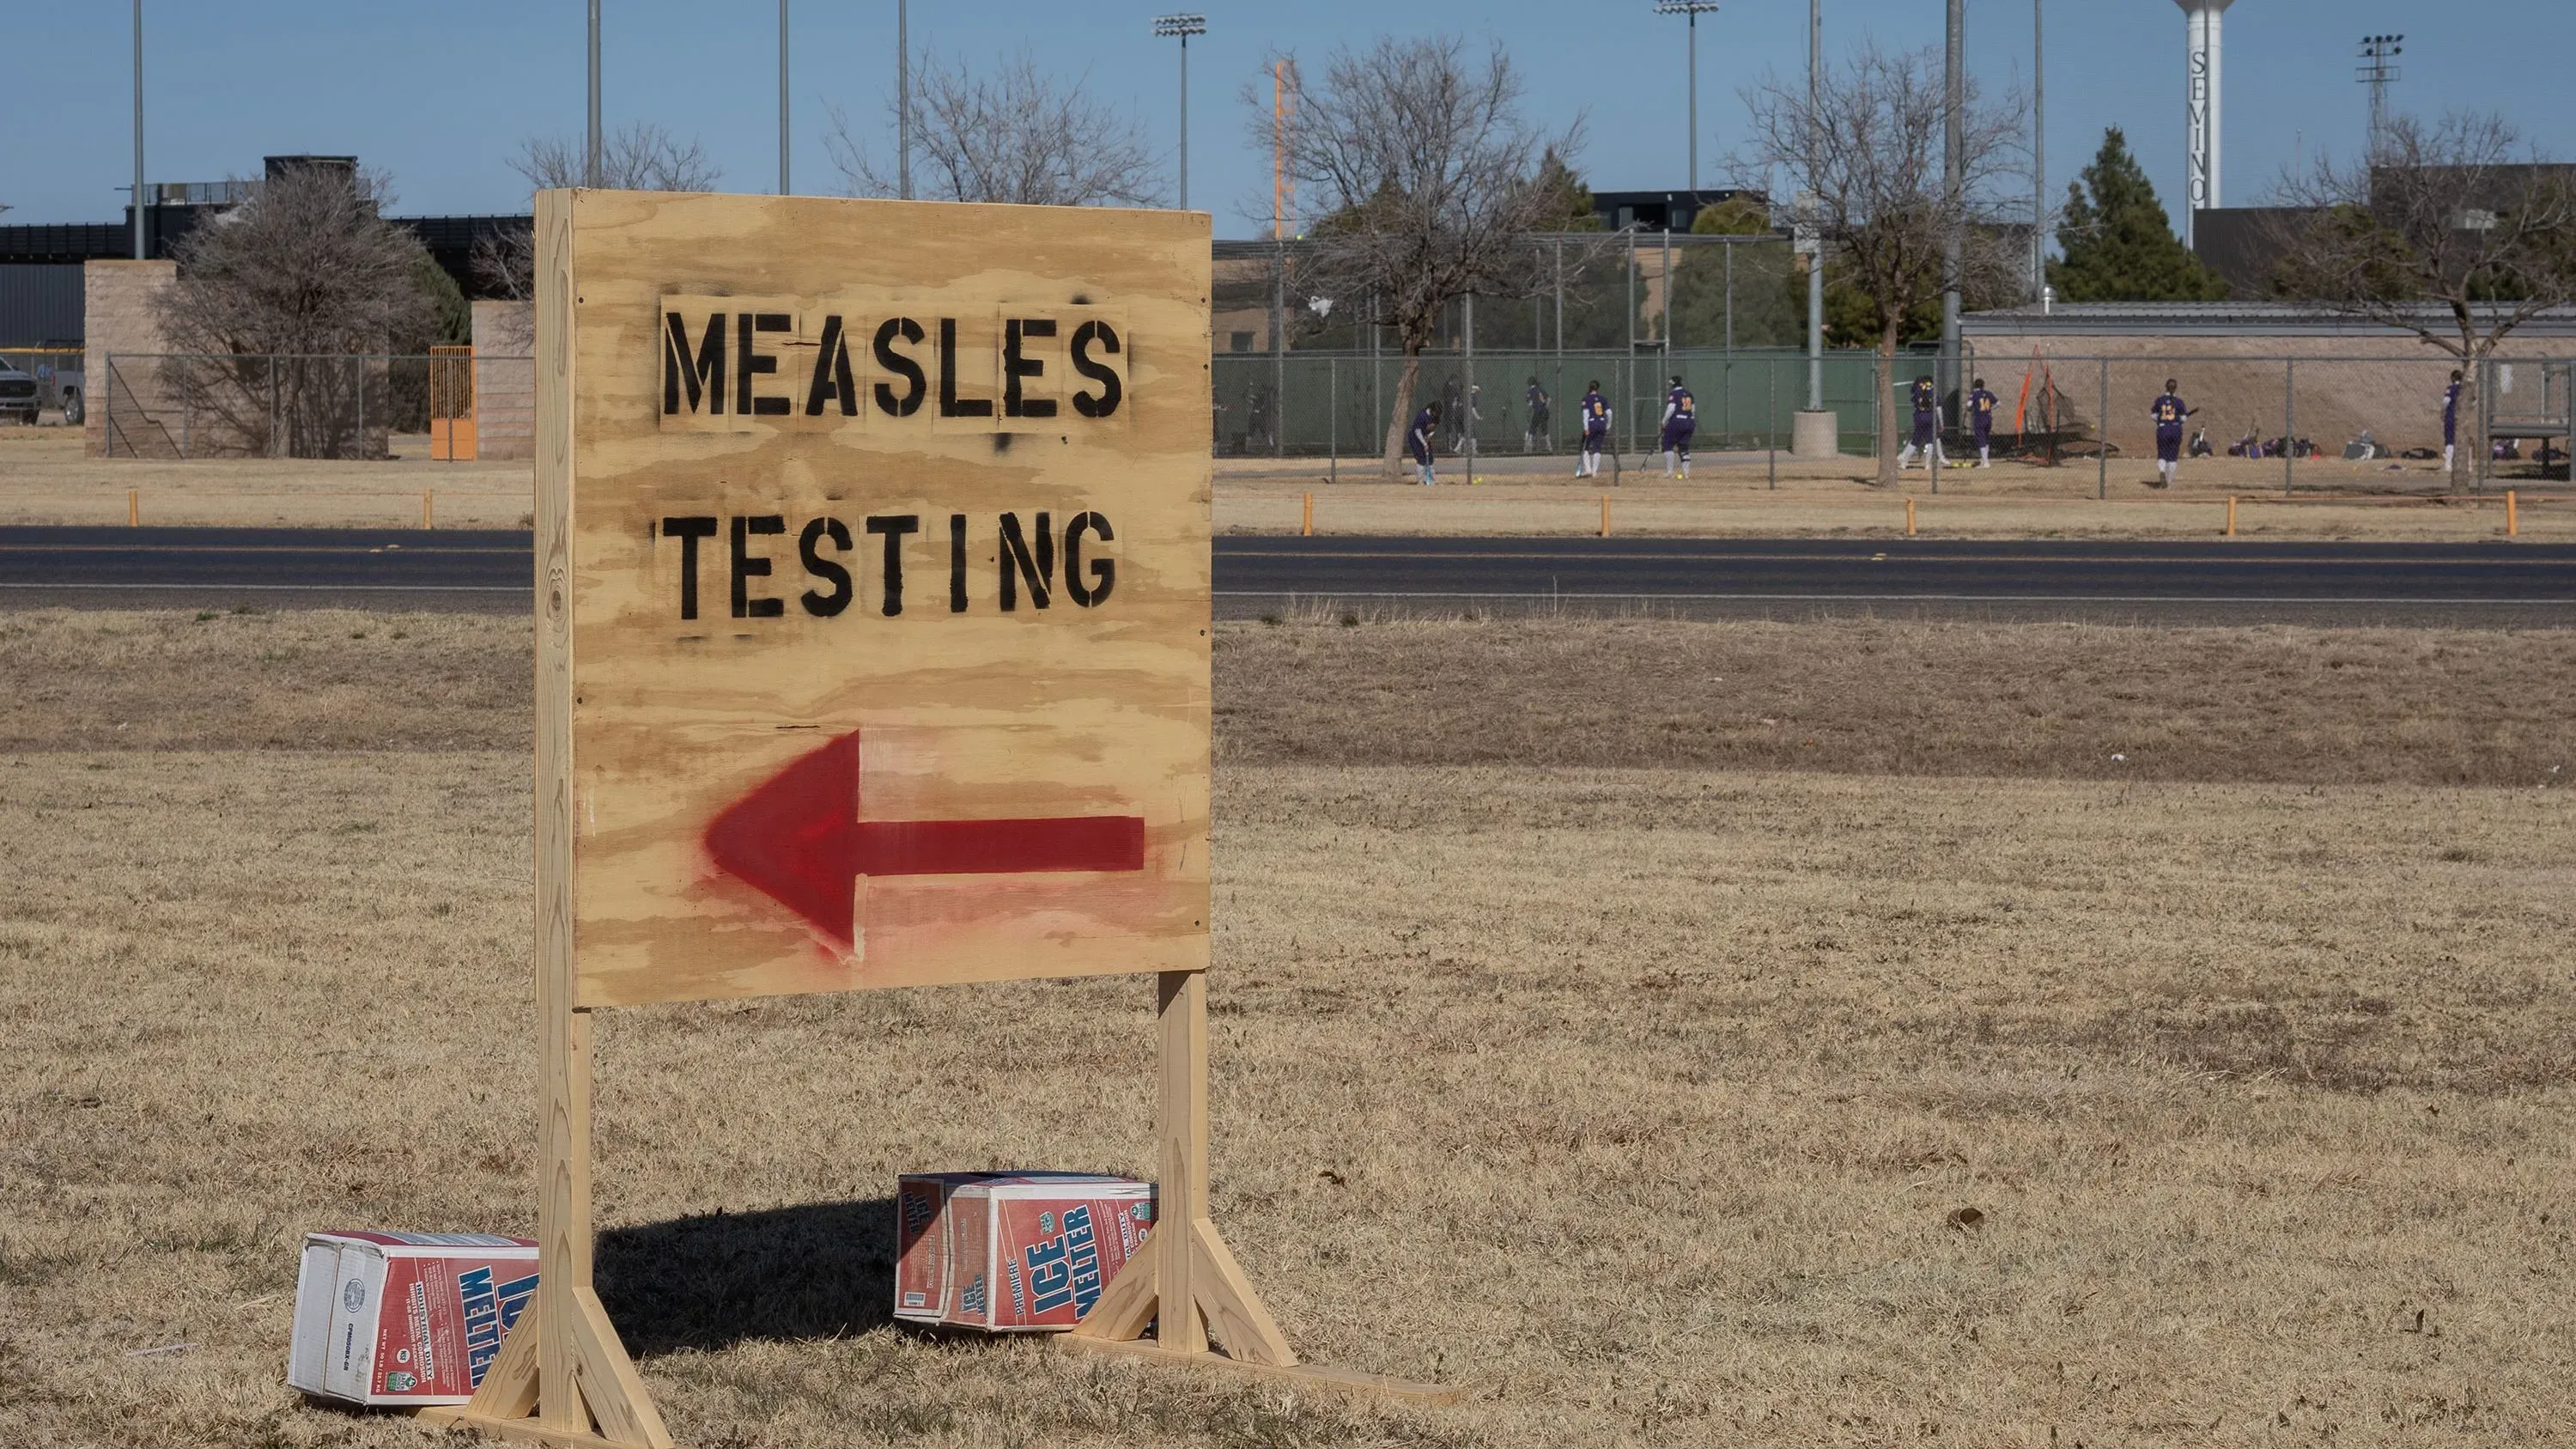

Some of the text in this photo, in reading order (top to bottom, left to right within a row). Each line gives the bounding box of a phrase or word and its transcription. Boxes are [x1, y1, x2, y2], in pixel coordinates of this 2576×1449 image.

[663, 312, 1122, 418] MEASLES
[663, 511, 1115, 620] TESTING
[1007, 1257, 1024, 1316] PREMIERE
[1024, 1233, 1073, 1315] ICE
[1062, 1203, 1103, 1319] MELTER
[416, 1283, 434, 1379] INDUSTRIAL DUTY
[416, 1342, 427, 1383] CORROSION
